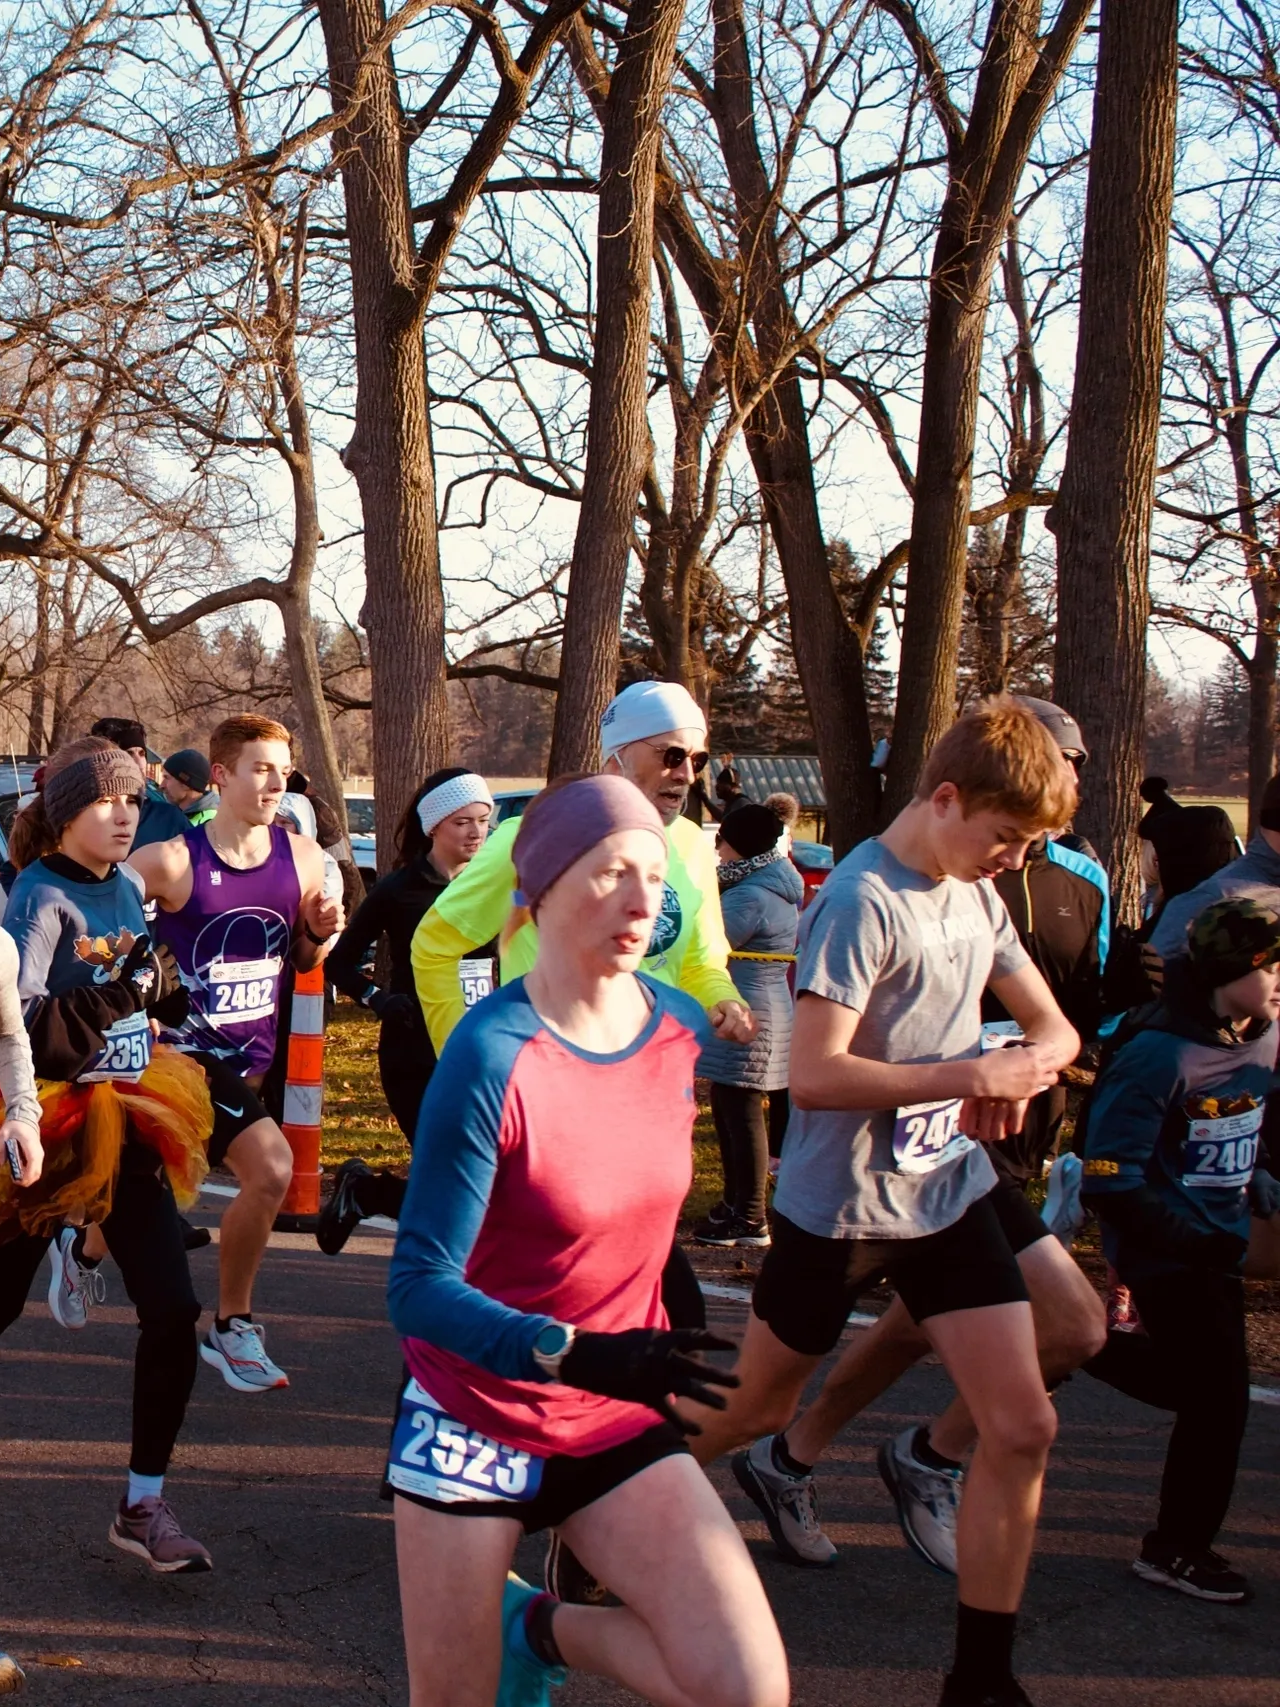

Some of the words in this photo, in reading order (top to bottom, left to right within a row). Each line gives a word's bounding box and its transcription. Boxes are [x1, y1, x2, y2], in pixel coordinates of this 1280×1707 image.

[216, 978, 274, 1012] 2482
[93, 1032, 150, 1070] 2351
[902, 1101, 960, 1160] 247
[400, 1410, 531, 1494] 2523
